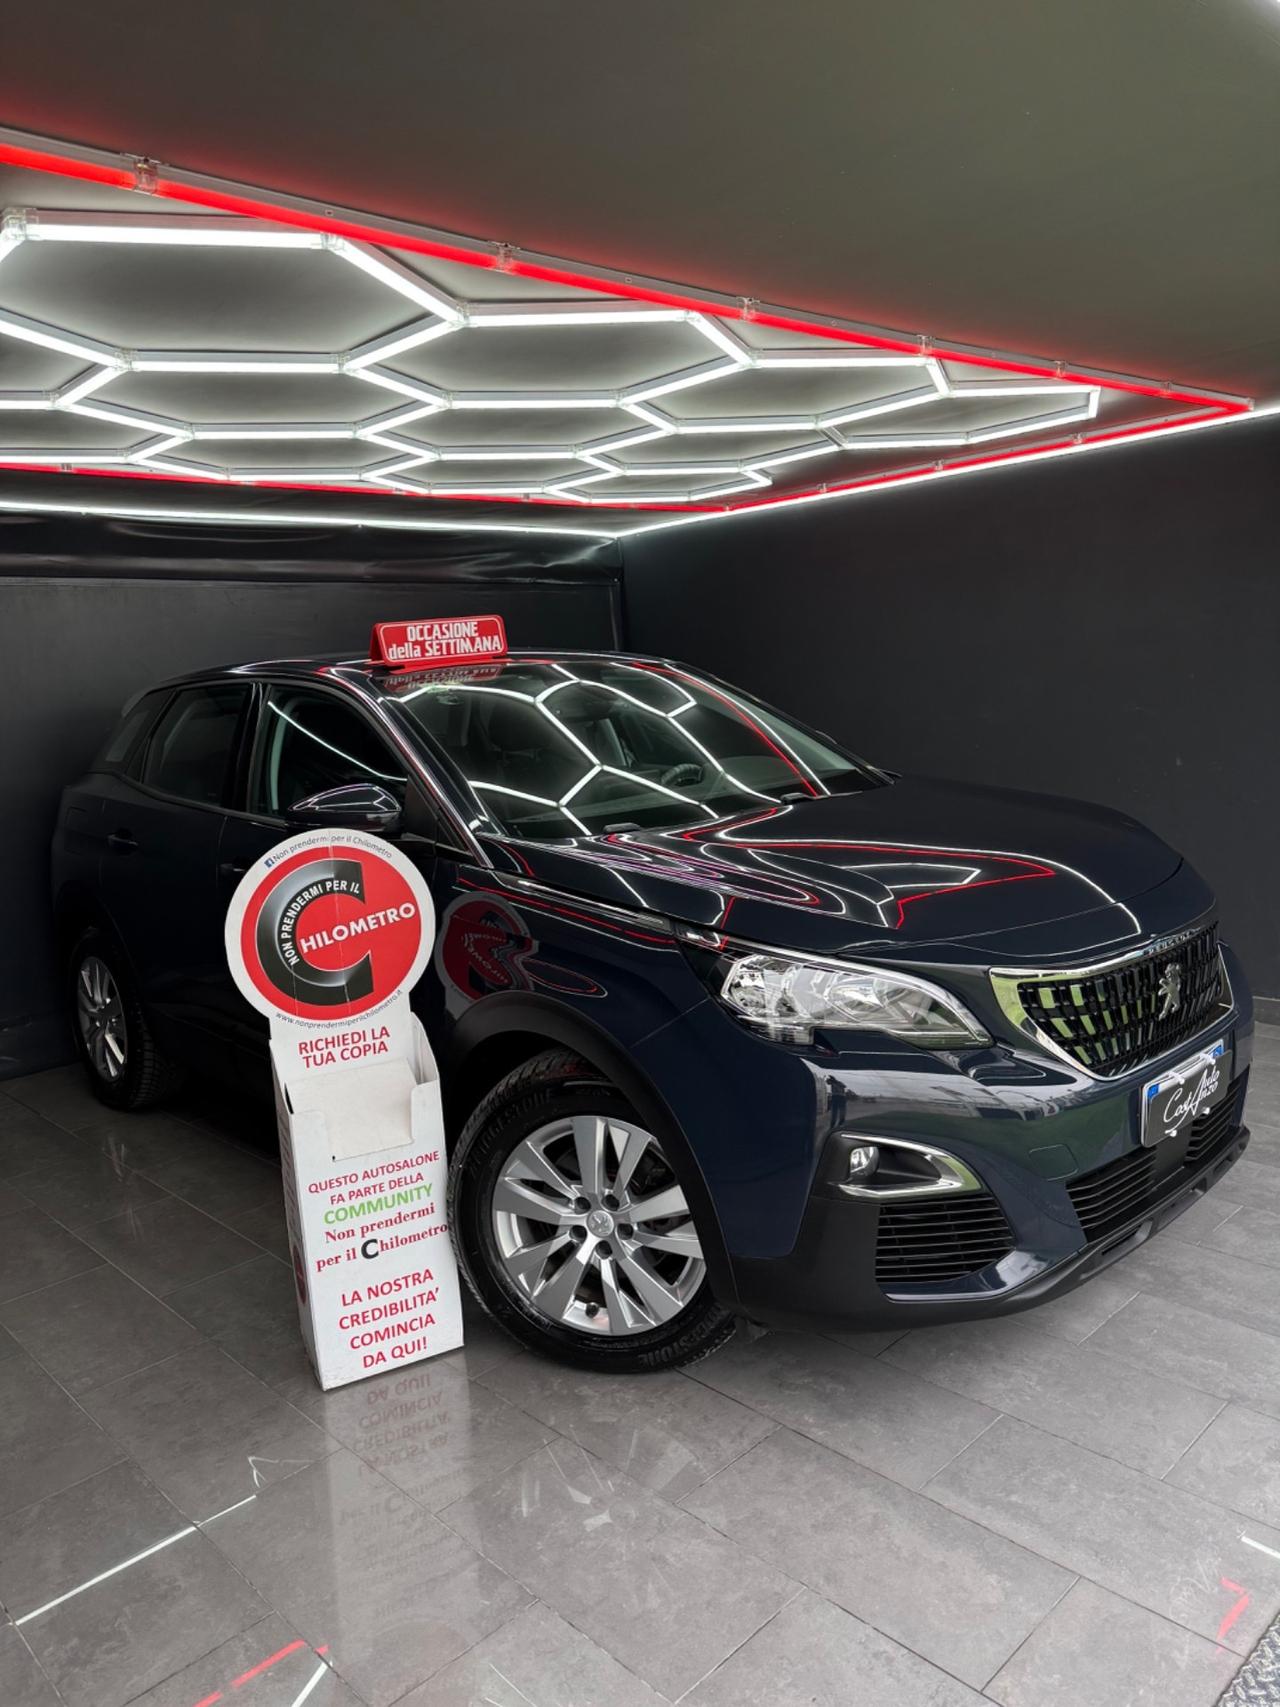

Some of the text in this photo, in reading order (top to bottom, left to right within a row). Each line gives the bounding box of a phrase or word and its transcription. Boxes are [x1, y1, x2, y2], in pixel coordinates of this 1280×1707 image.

[388, 635, 501, 660] della SETTIMANA
[406, 621, 479, 642] OCCASIONE
[273, 849, 289, 861] Non
[330, 835, 345, 843] per
[353, 836, 393, 859] Chilometro
[281, 880, 360, 966] NON PRENDERMI PER IL
[298, 1025, 390, 1056] RICHIEDI LA
[302, 1041, 389, 1069] TUA COPIA
[308, 1150, 440, 1195] QUESTO AUTOSALONE
[329, 1172, 425, 1206] FA PARTE DELLA
[323, 1183, 434, 1226] COMMUNITY
[324, 1202, 436, 1244] Non prendermi
[316, 1224, 448, 1272] per il Chilometro
[341, 1268, 435, 1308] LA NOSTRA
[338, 1287, 440, 1331] CREDIBILITA’
[349, 1313, 436, 1350] COMINCIA
[362, 1336, 428, 1369] DA QUI!
